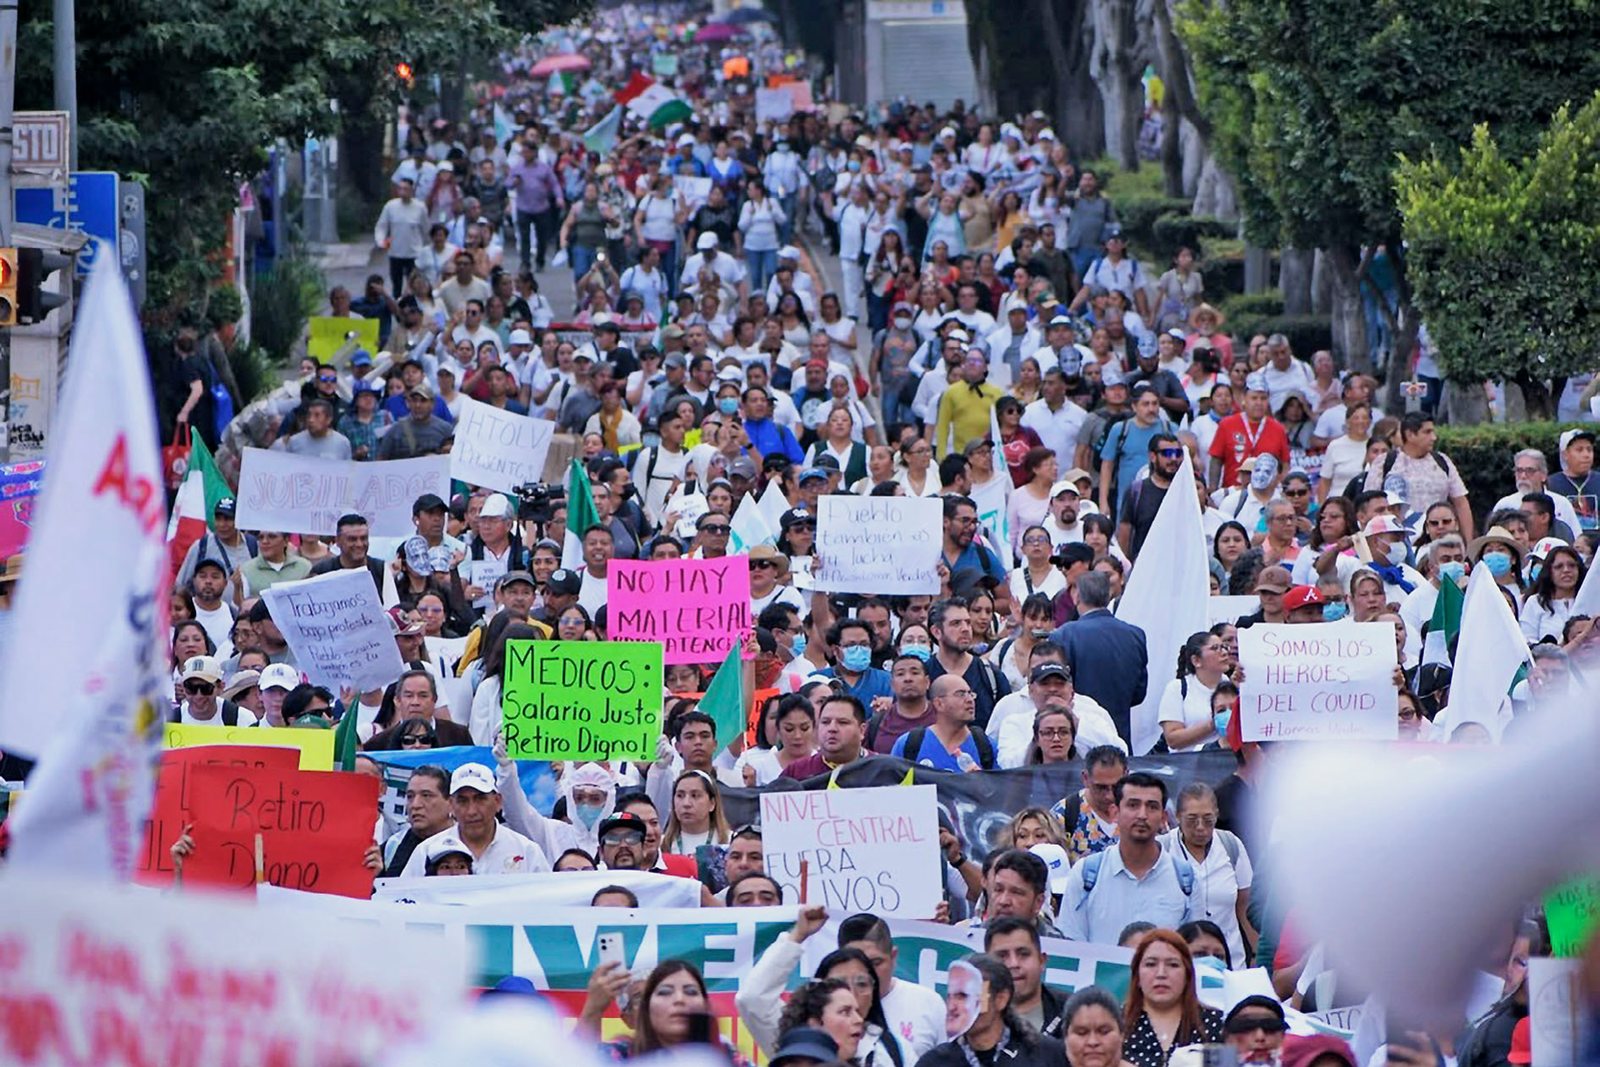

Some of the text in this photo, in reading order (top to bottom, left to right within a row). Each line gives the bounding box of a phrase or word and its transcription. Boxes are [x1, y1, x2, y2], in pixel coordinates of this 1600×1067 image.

[249, 472, 441, 510] JUBILADOS
[616, 565, 730, 596] NO HAY
[274, 592, 368, 619] Trabajamos
[618, 601, 751, 637] MATERIAL
[1338, 638, 1373, 659] LOS
[1266, 663, 1350, 685] HEROES
[504, 690, 657, 726] Salario Justo
[1258, 691, 1376, 714] DEL COVID
[504, 722, 648, 762] Retiro Digno!
[225, 778, 325, 833] Retiro
[764, 792, 841, 823] NIVEL
[816, 815, 926, 847] CENTRAL
[766, 848, 857, 878] FUERA
[780, 870, 900, 912] OIVOS
